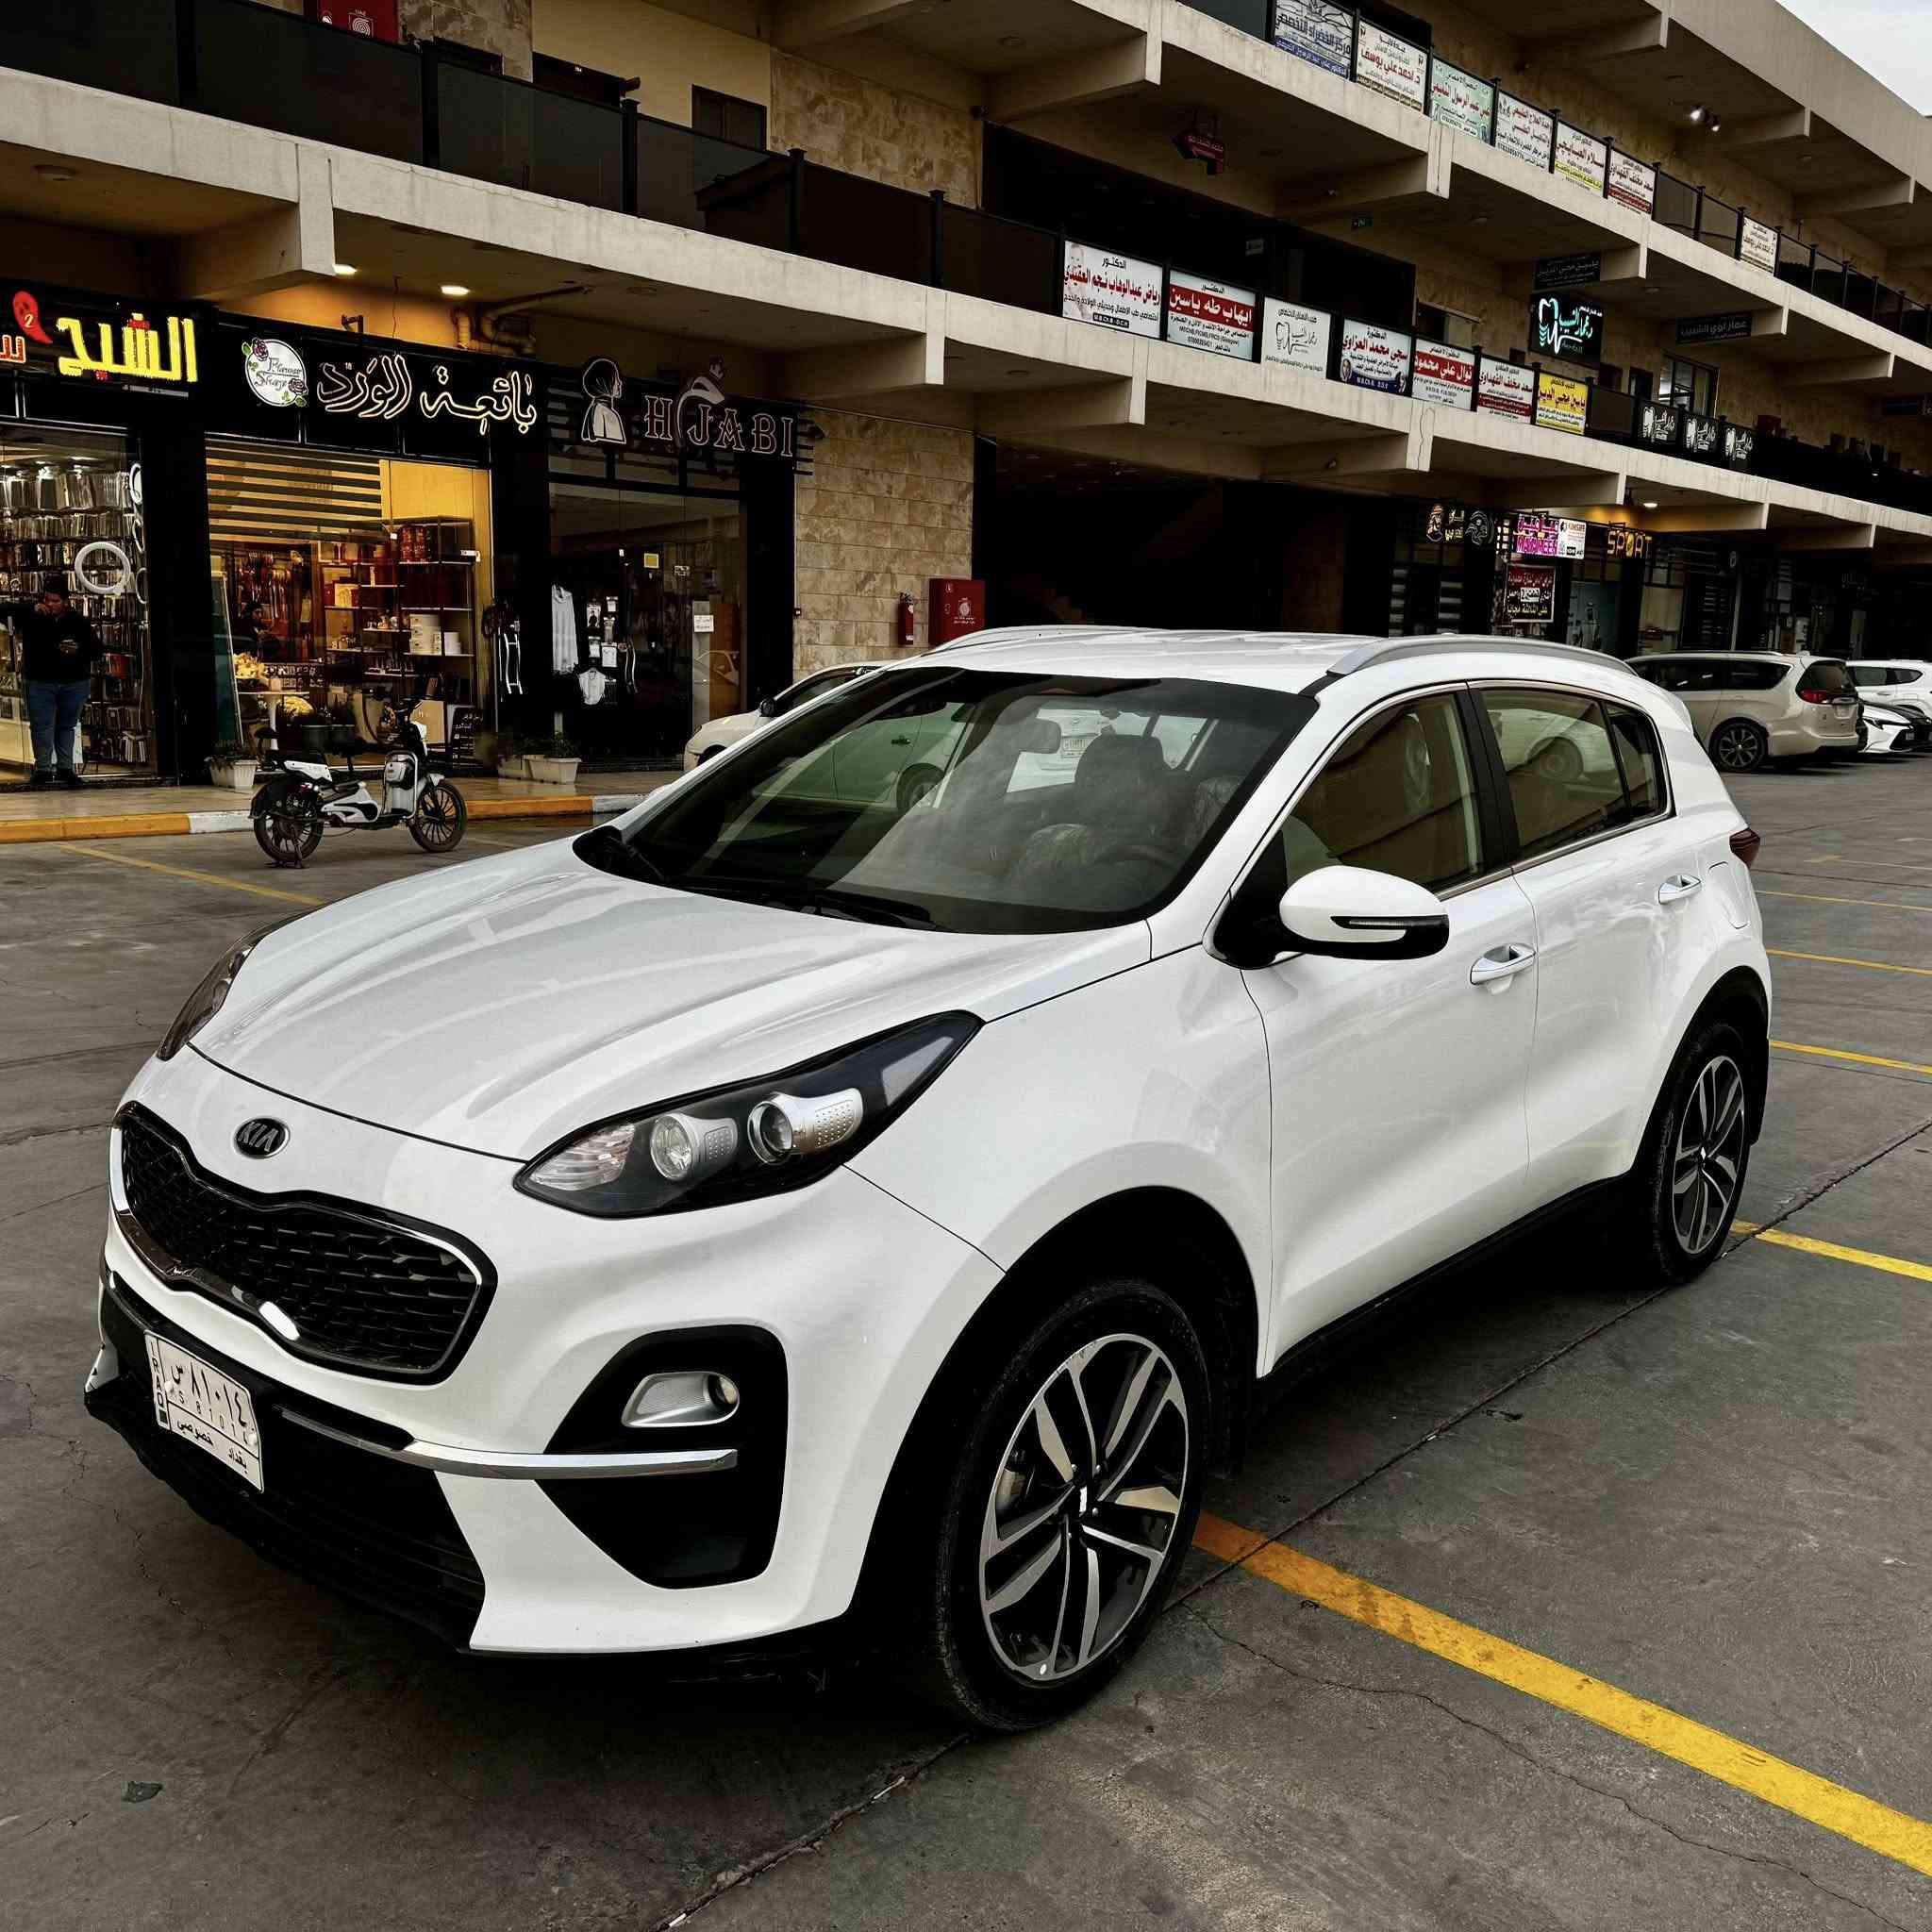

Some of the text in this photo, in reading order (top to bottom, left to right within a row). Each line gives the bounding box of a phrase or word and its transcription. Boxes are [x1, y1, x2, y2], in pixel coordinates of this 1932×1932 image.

[1169, 288, 1201, 315] ياسين
[1204, 296, 1222, 315] طه
[227, 1448, 248, 1474] بغداد
